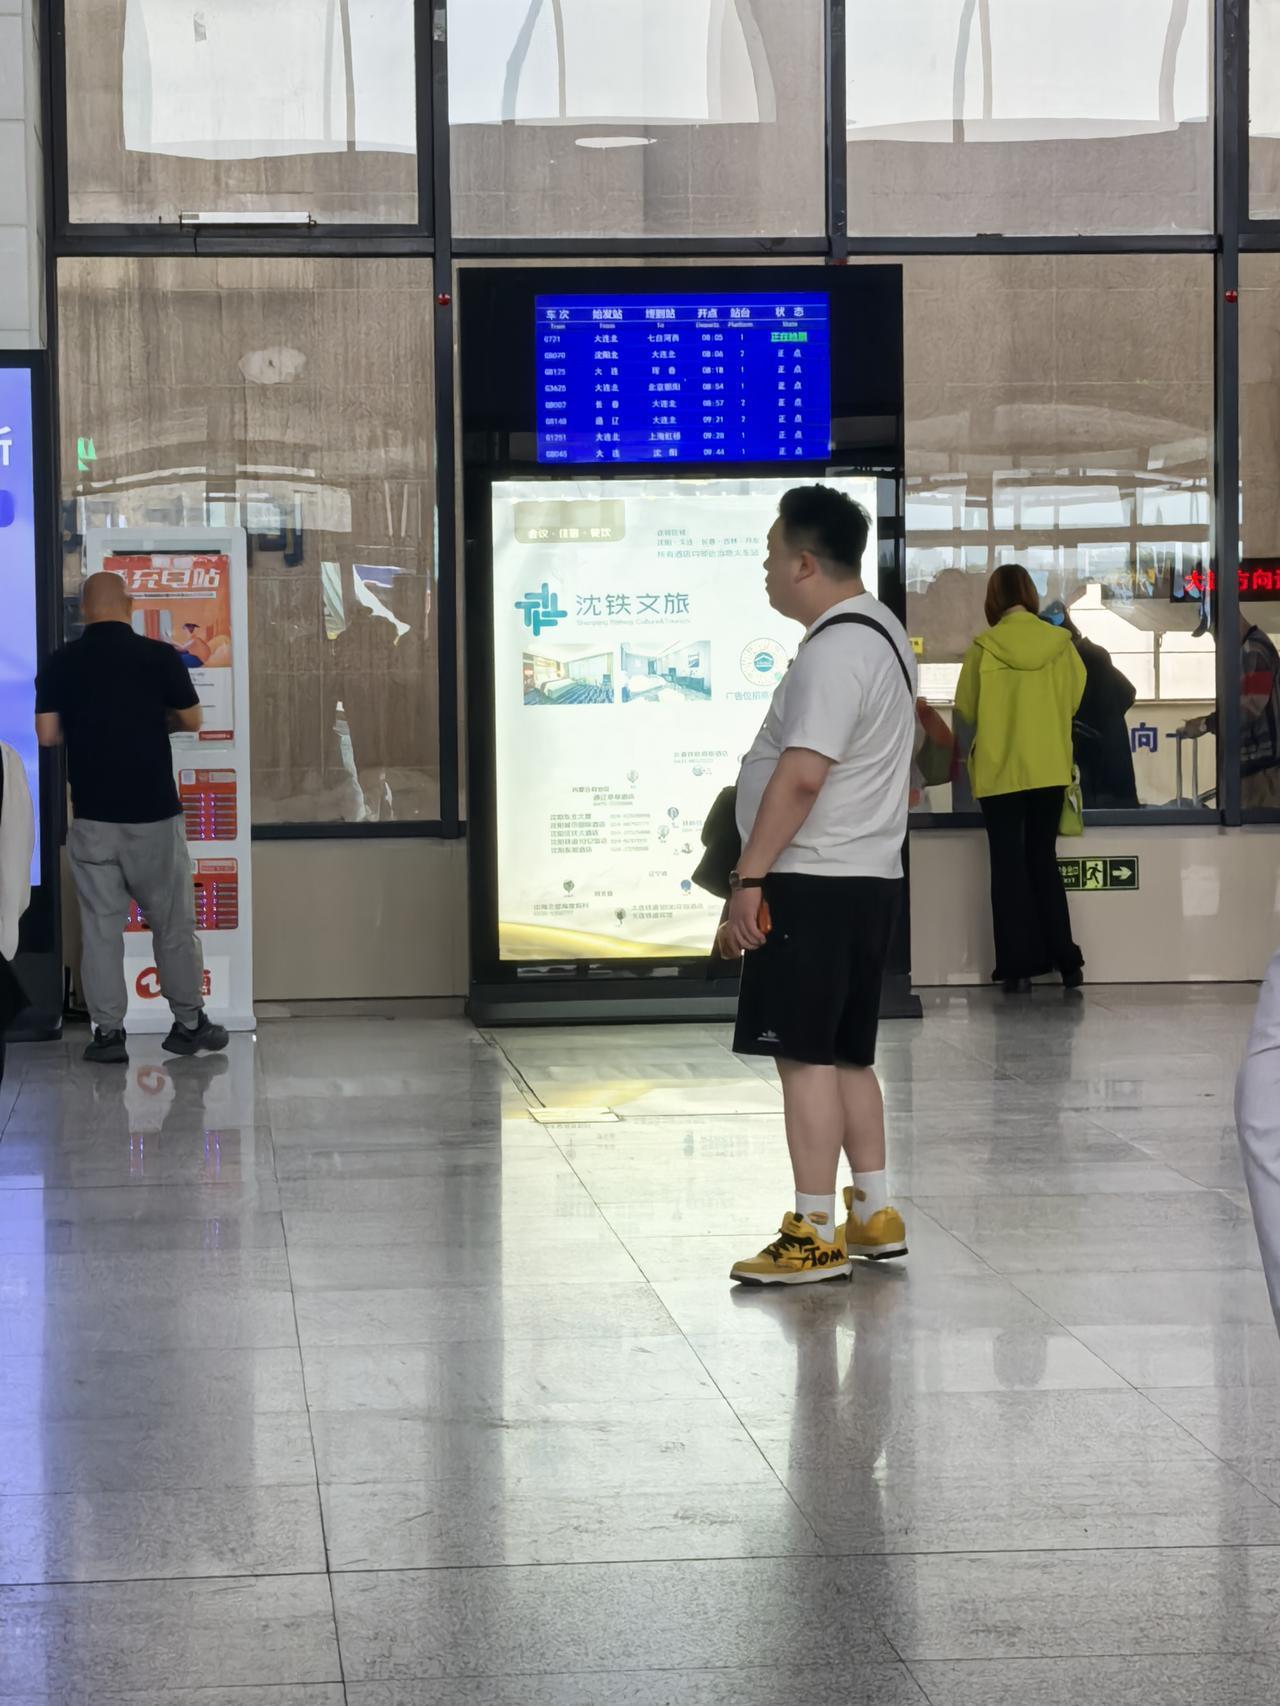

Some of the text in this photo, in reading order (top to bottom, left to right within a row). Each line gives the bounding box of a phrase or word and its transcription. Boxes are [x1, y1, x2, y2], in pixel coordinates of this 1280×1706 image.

[545, 309, 570, 320] 车次
[592, 308, 623, 320] 始发站
[697, 307, 718, 318] 开点
[730, 307, 750, 318] 站台
[775, 306, 804, 317] 状态
[651, 350, 676, 359] 大连北
[594, 383, 620, 392] 大连北
[652, 399, 677, 408] 大连北
[652, 416, 677, 424] 大连北
[595, 432, 620, 441] 大连北
[576, 592, 690, 616] 沈铁文旅
